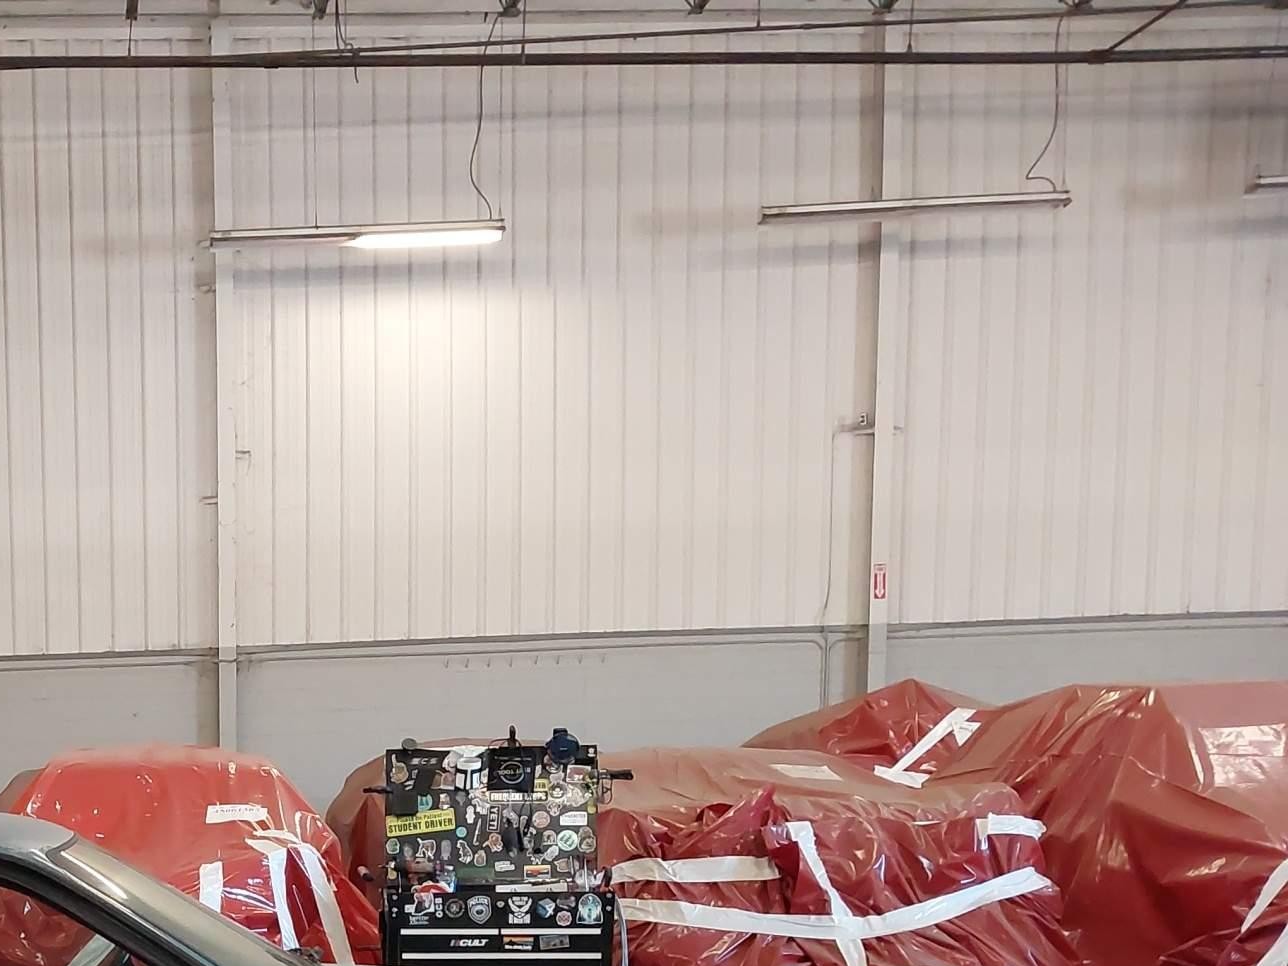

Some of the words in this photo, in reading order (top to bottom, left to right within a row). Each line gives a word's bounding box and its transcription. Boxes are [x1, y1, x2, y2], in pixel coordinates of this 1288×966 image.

[388, 821, 422, 834] STUDENT
[424, 817, 454, 830] DRIVER
[489, 805, 498, 830] YETI
